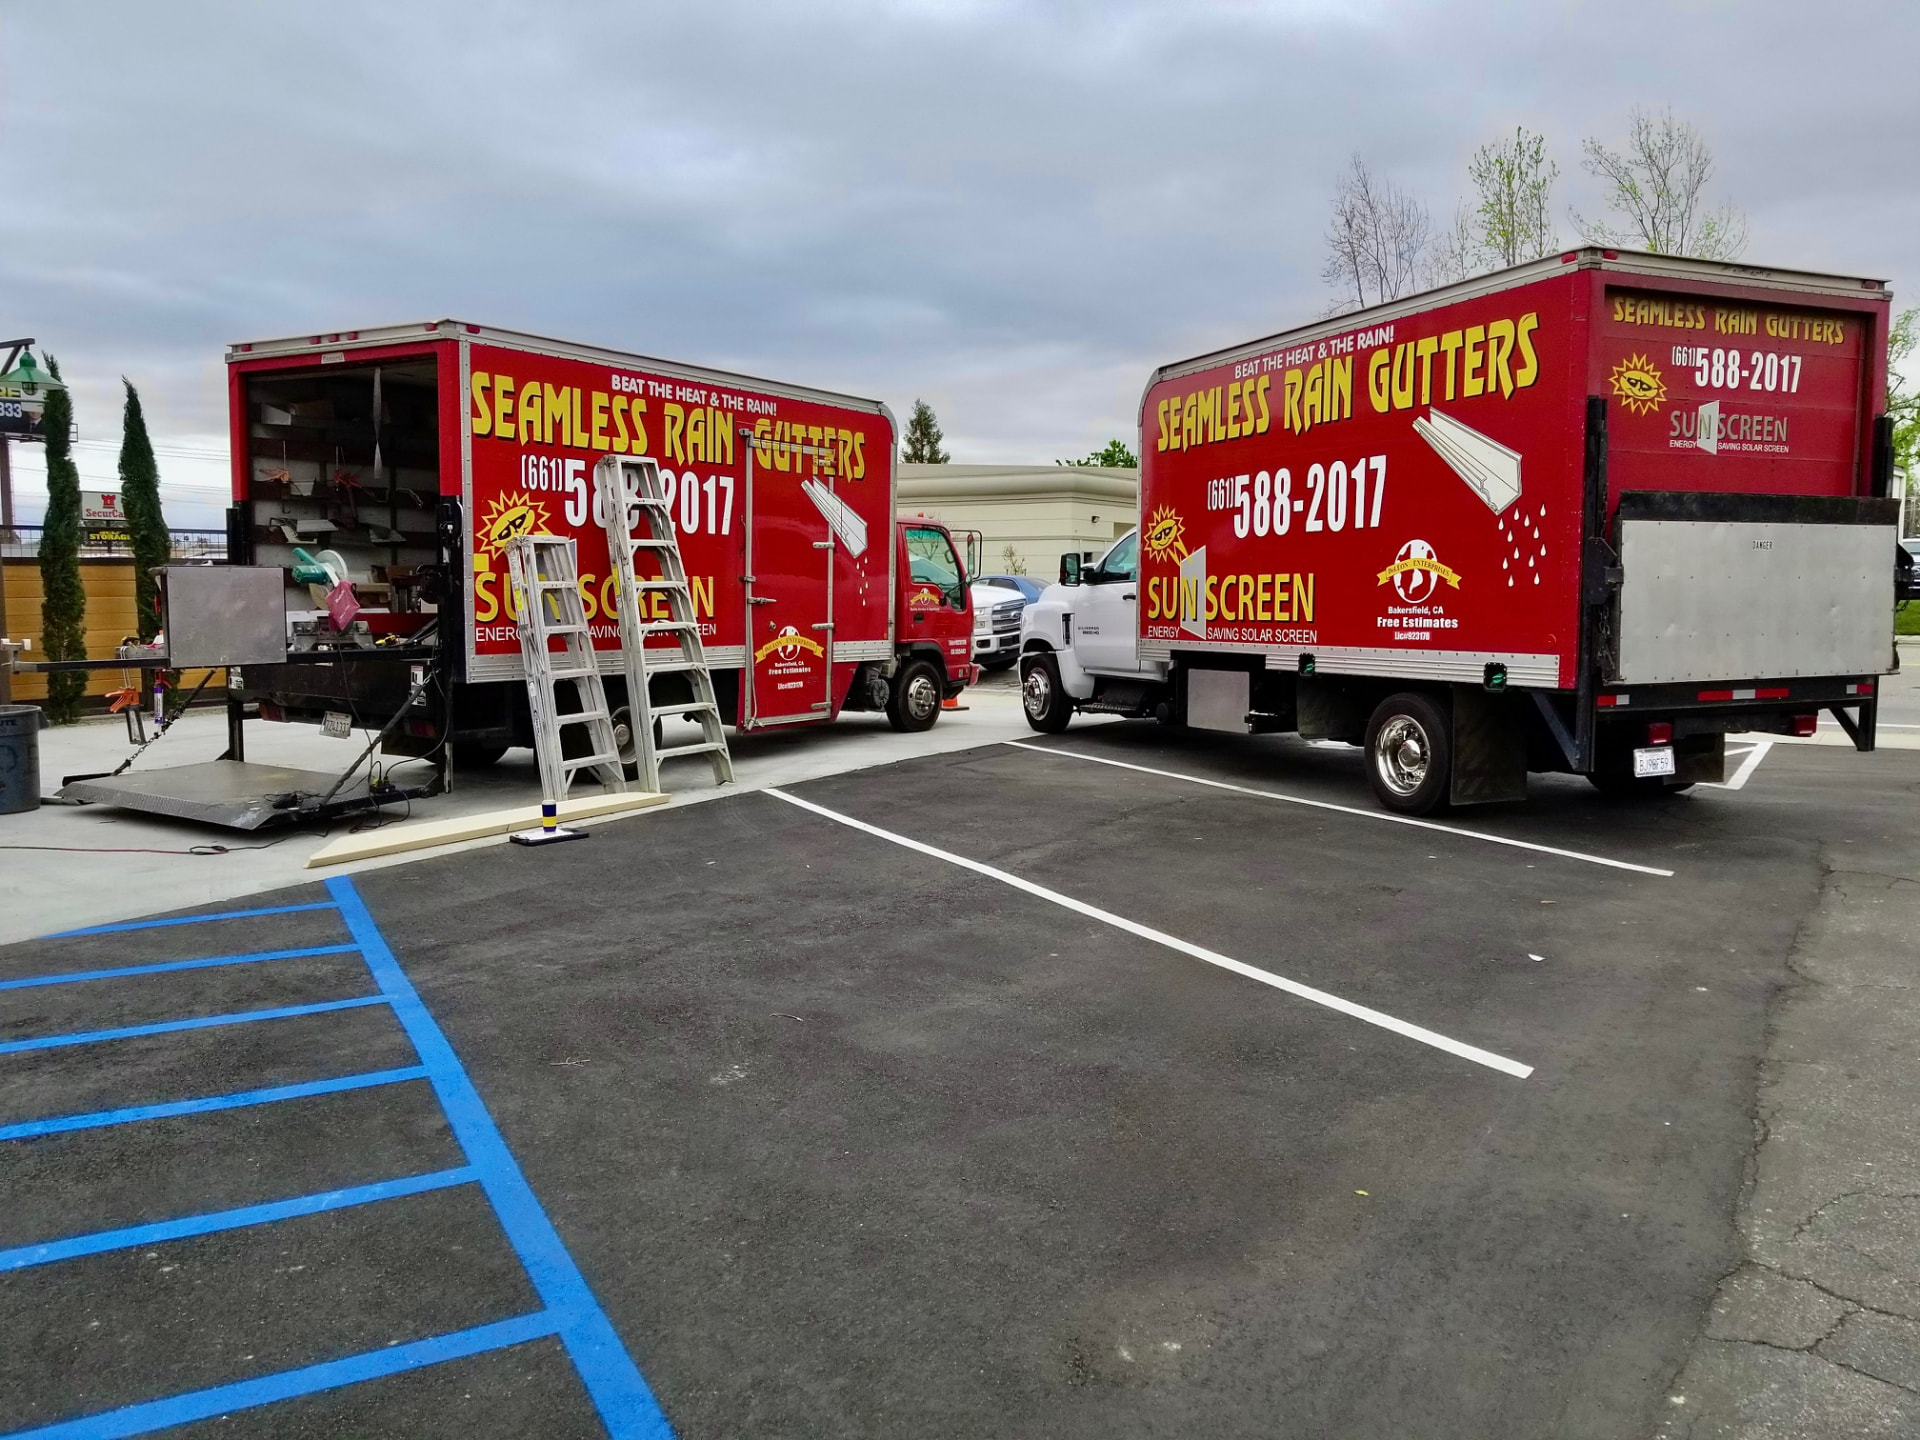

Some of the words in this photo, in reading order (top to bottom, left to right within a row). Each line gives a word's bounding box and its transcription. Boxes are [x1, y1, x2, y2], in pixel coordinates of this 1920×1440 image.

[1614, 297, 1706, 331] SEAMLESS
[1715, 308, 1758, 336] RAIN
[1765, 314, 1844, 346] GUTTERS
[1235, 360, 1260, 379] BEAT
[1262, 353, 1284, 373] THE
[1286, 345, 1316, 367] HEAT
[1317, 342, 1328, 359] &
[1329, 335, 1355, 356] THE
[1357, 325, 1395, 351] RAIN!
[611, 374, 645, 395] BEAT
[647, 380, 673, 400] THE
[675, 386, 708, 405] HEAT
[709, 392, 720, 407] &
[721, 394, 744, 411] THE
[746, 399, 778, 417] RAIN!
[1157, 373, 1271, 453] SEAMLESS
[1283, 355, 1353, 437] RAIN
[1368, 312, 1540, 413] GUTTERS
[471, 370, 650, 456] SEAMLESS
[662, 402, 735, 466] RAIN
[754, 417, 867, 483] GUTTERS
[1669, 439, 1697, 449] ENERGY
[1717, 442, 1741, 451] SAVING
[1741, 443, 1763, 452] SOLAR
[1763, 445, 1789, 454] SCREEN
[1376, 617, 1400, 628] Free
[1402, 617, 1459, 628] Estimates
[1432, 606, 1444, 615] CA
[475, 626, 521, 642] ENER
[1147, 625, 1180, 639] ENERGY
[1207, 627, 1239, 641] SAVING
[1240, 628, 1273, 642] SOLAR
[1275, 629, 1318, 644] SCREEN
